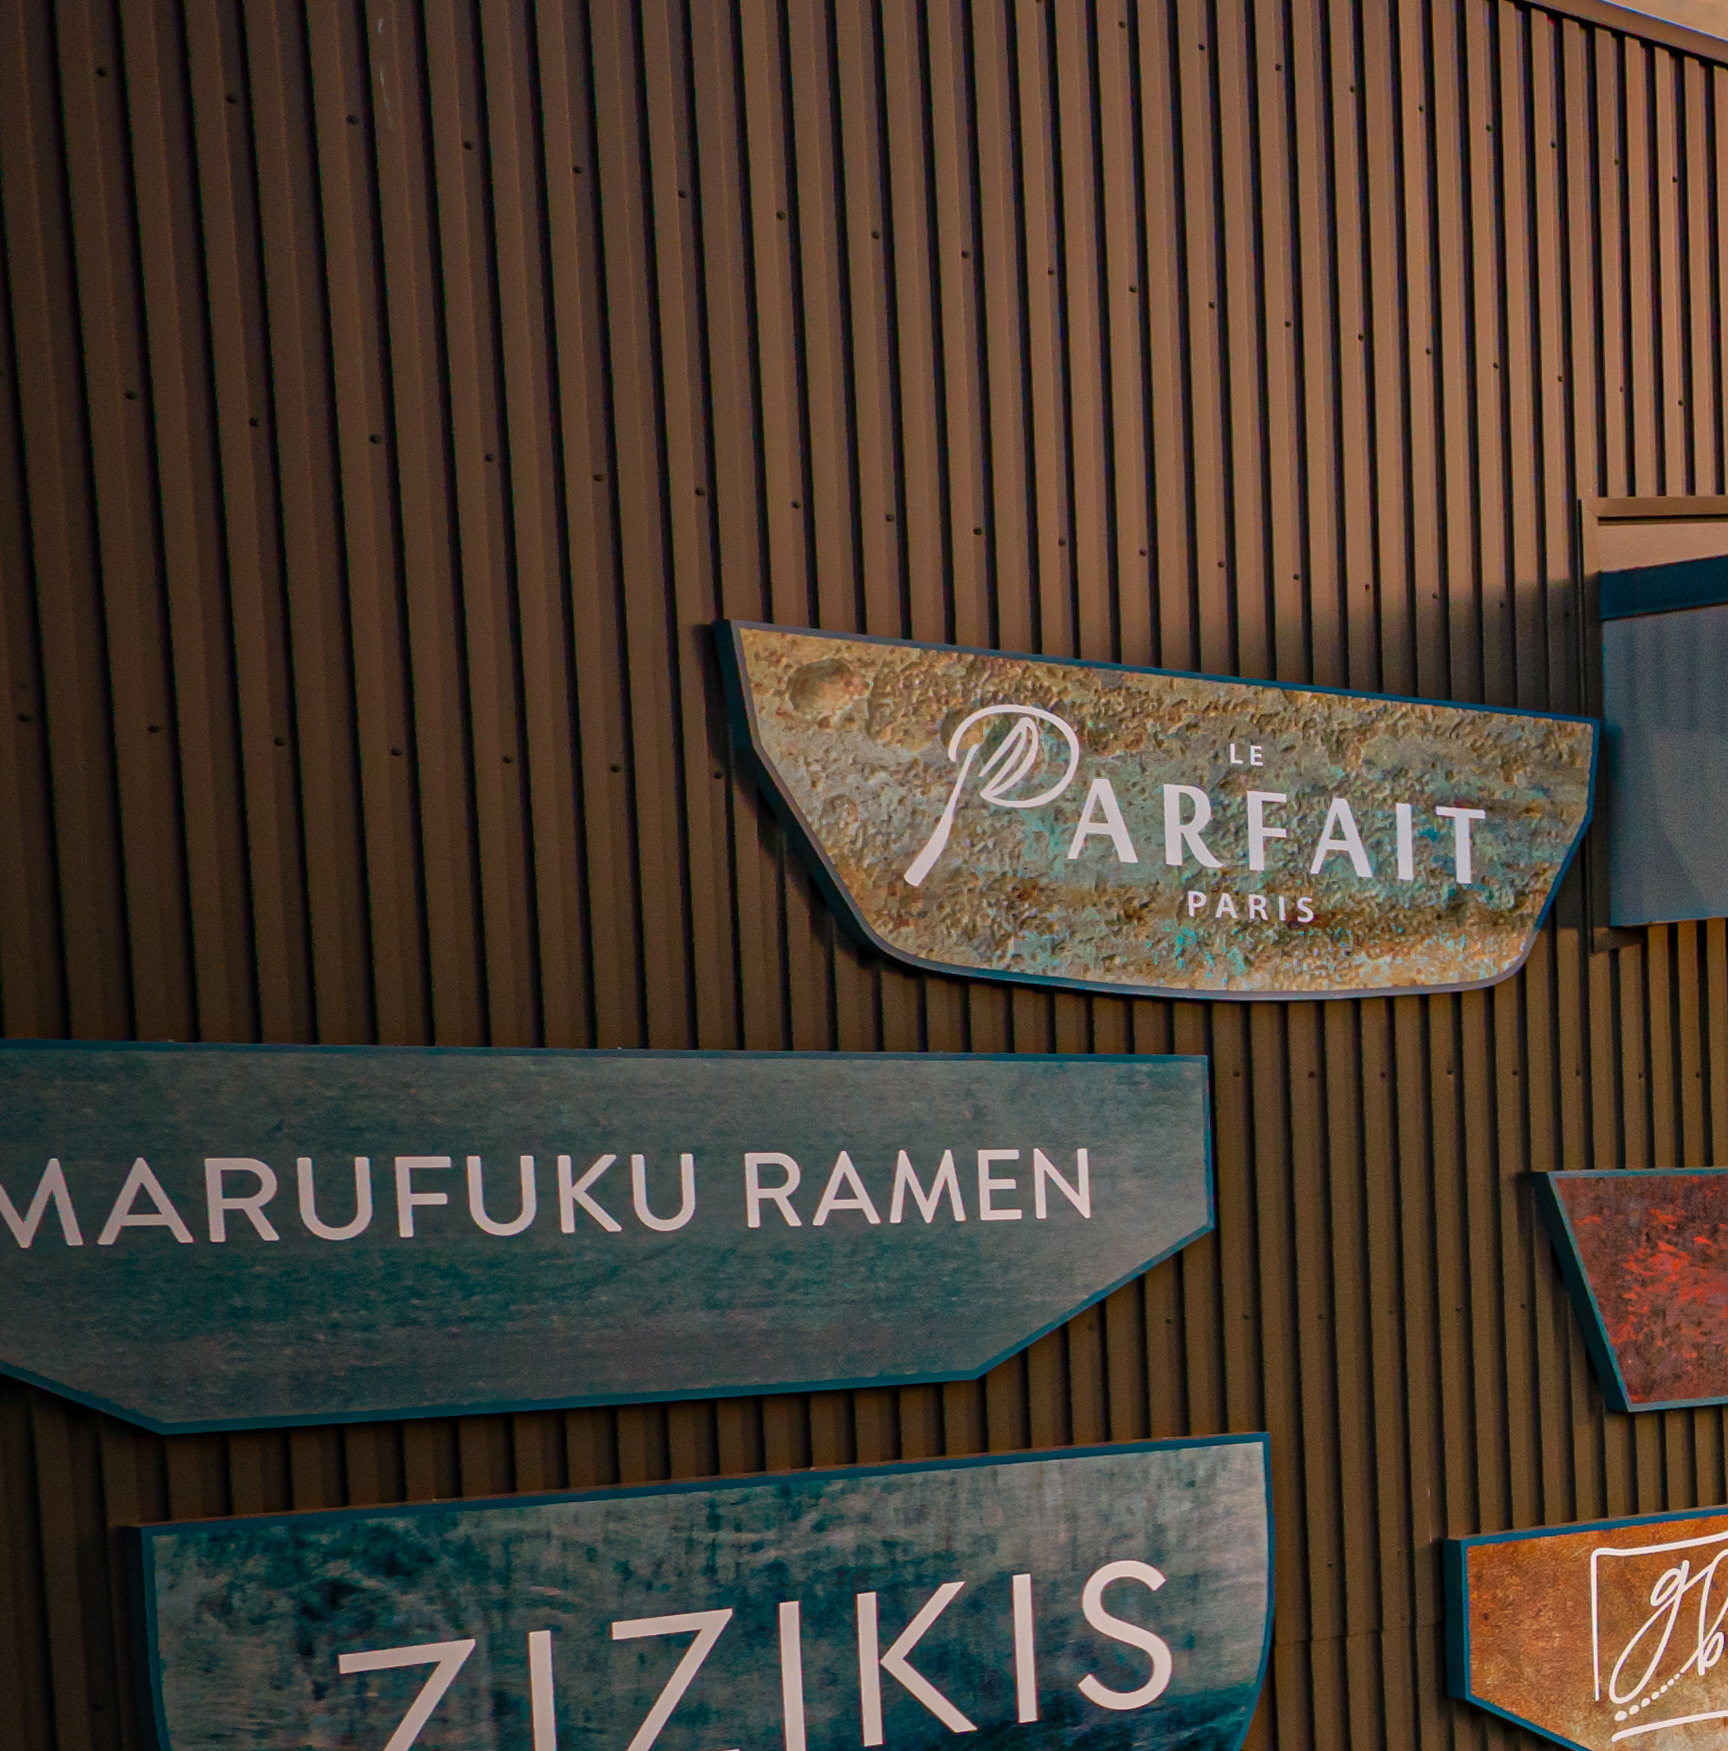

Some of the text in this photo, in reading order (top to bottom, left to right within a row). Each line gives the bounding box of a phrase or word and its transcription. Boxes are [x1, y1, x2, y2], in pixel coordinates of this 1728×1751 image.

[1229, 742, 1265, 767] LE
[903, 704, 1487, 887] PARFAIT
[1186, 889, 1315, 922] PARIS
[0, 1147, 1093, 1249] MARUFUKU RAMEN
